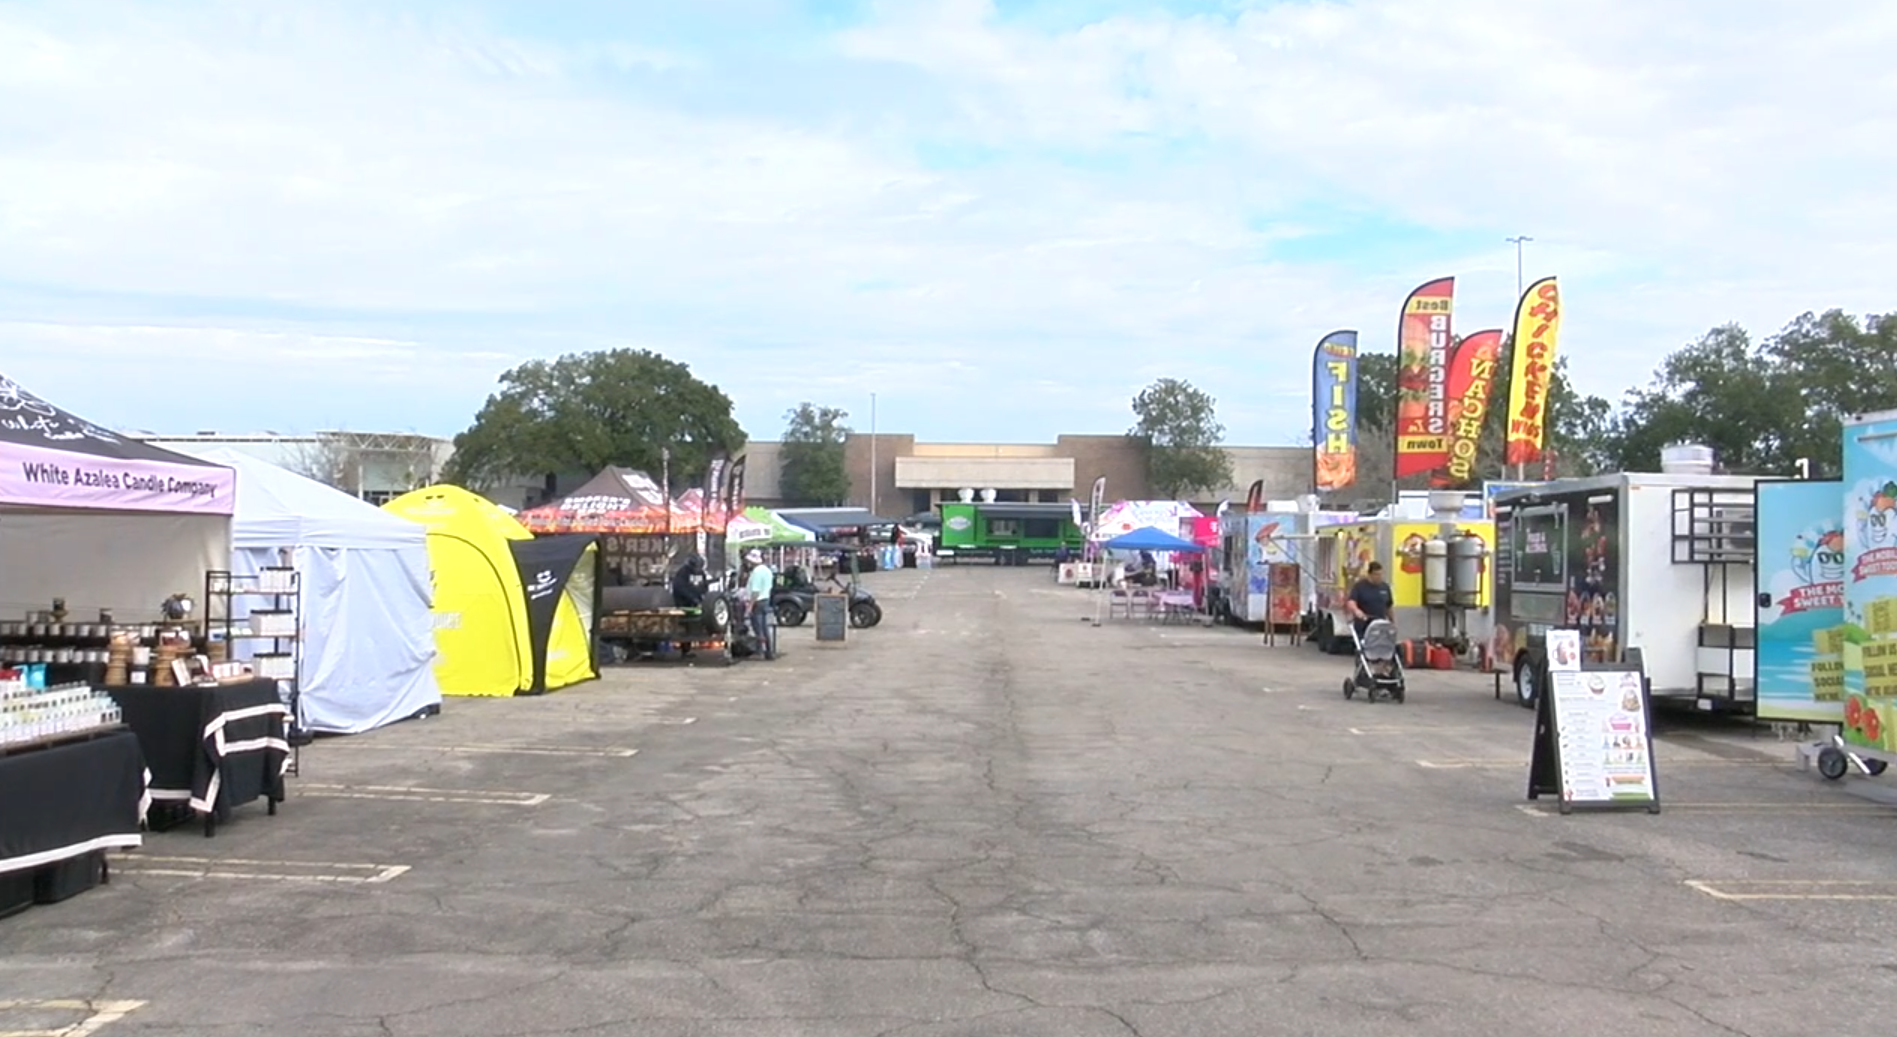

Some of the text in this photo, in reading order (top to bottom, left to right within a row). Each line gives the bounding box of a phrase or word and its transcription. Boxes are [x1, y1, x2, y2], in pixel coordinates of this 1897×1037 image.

[1520, 284, 1557, 419] CHICKEN
[23, 461, 218, 499] White Azalea Candle Company
[1793, 596, 1835, 608] SWEET
[1799, 584, 1824, 598] THE
